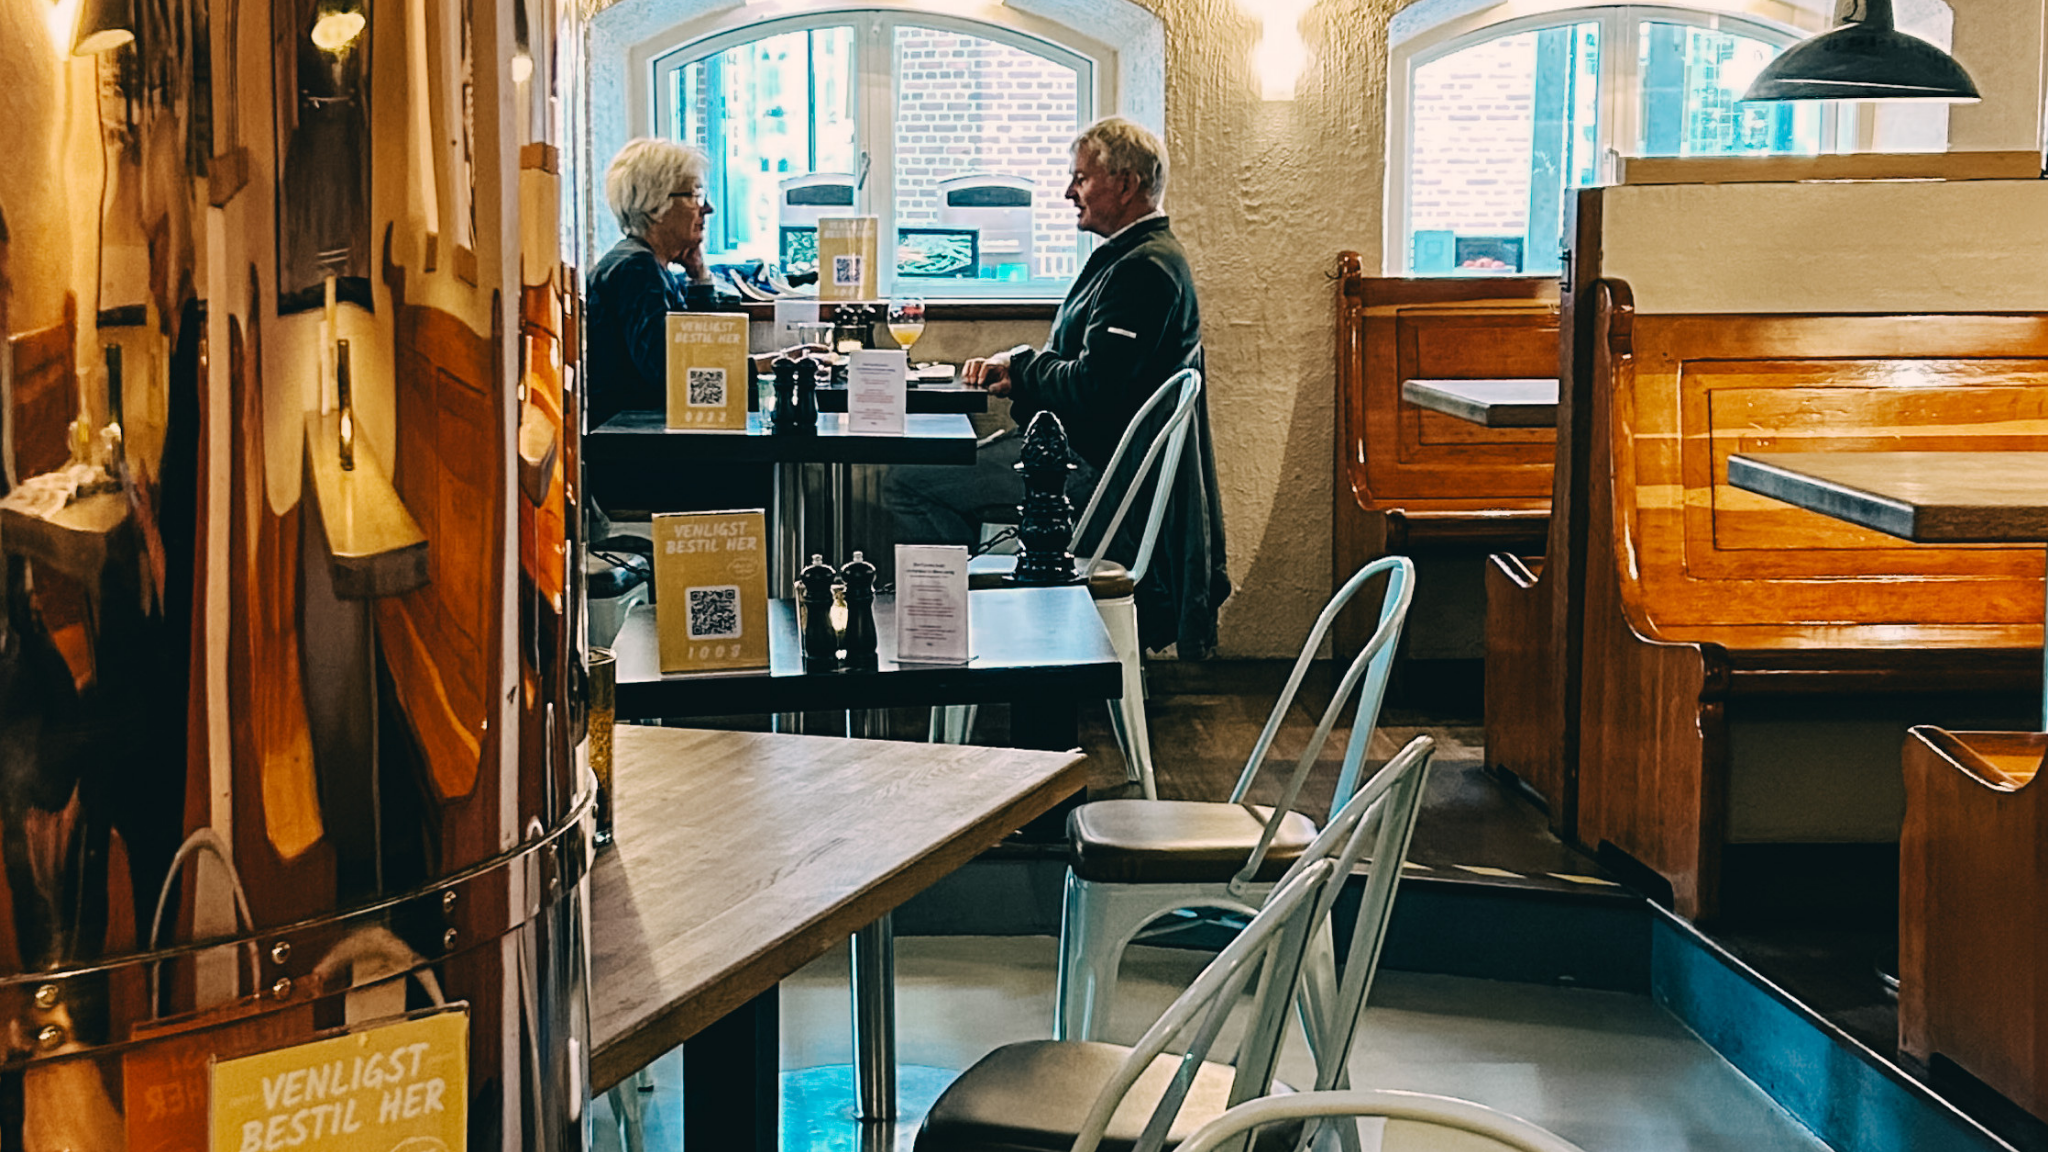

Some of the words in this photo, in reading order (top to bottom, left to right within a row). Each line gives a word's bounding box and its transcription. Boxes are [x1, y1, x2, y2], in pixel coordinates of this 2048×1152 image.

[666, 539, 719, 555] BESTIL
[726, 537, 757, 550] HER
[674, 521, 748, 539] VENLIGST
[262, 1042, 430, 1111] VENLIGST
[239, 1098, 362, 1152] BESTIL
[379, 1077, 446, 1124] HER
